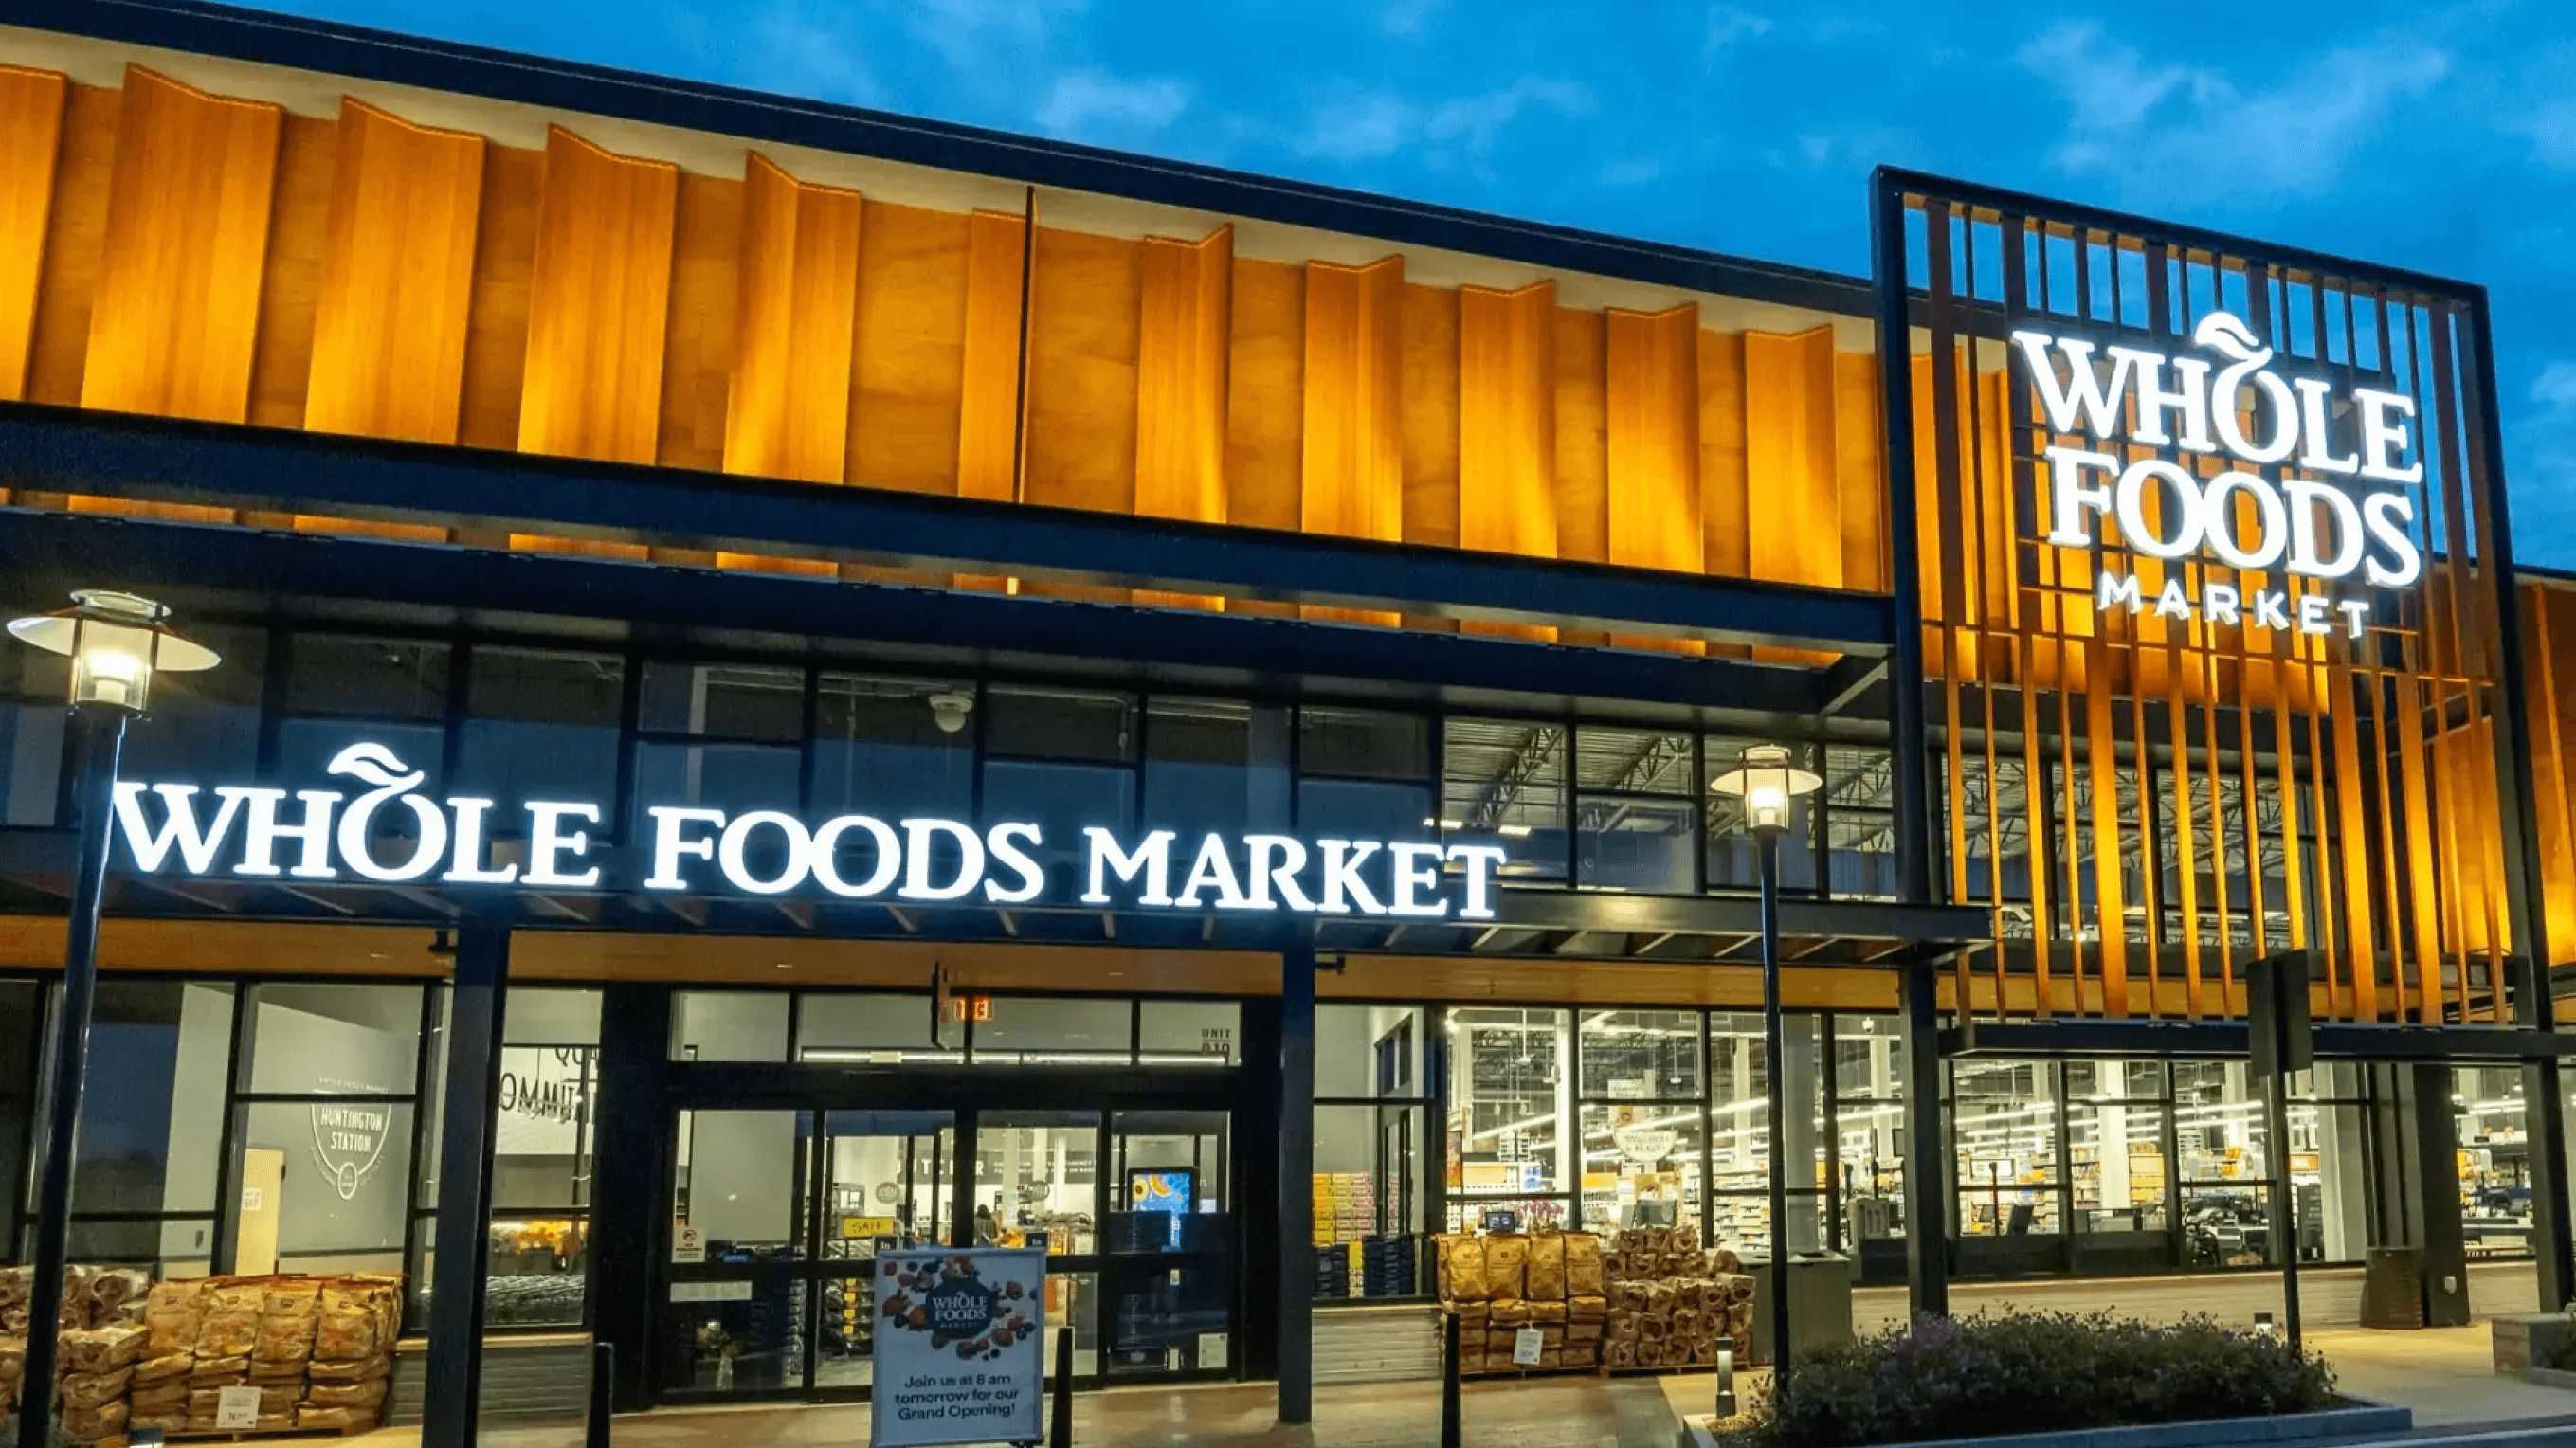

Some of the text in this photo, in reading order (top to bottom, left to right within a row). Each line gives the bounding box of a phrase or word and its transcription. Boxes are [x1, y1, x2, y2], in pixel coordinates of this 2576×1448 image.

[2010, 310, 2424, 485] WHOLE
[2044, 444, 2423, 588] FOODS
[2096, 570, 2371, 641] MARKET
[111, 742, 1509, 920] WHOLE FOODS MARKET
[1201, 1028, 1231, 1039] UNIT
[320, 1107, 383, 1131] HUNTINGTON
[330, 1131, 372, 1151] STATION
[932, 1291, 988, 1309] WHOLE
[934, 1309, 987, 1322] FOODS
[904, 1374, 936, 1388] Join
[940, 1377, 956, 1386] us
[959, 1375, 973, 1385] at
[988, 1375, 1011, 1385] am
[895, 1388, 1020, 1404] tomorrow for our
[898, 1403, 1016, 1421] Grand Opening!
